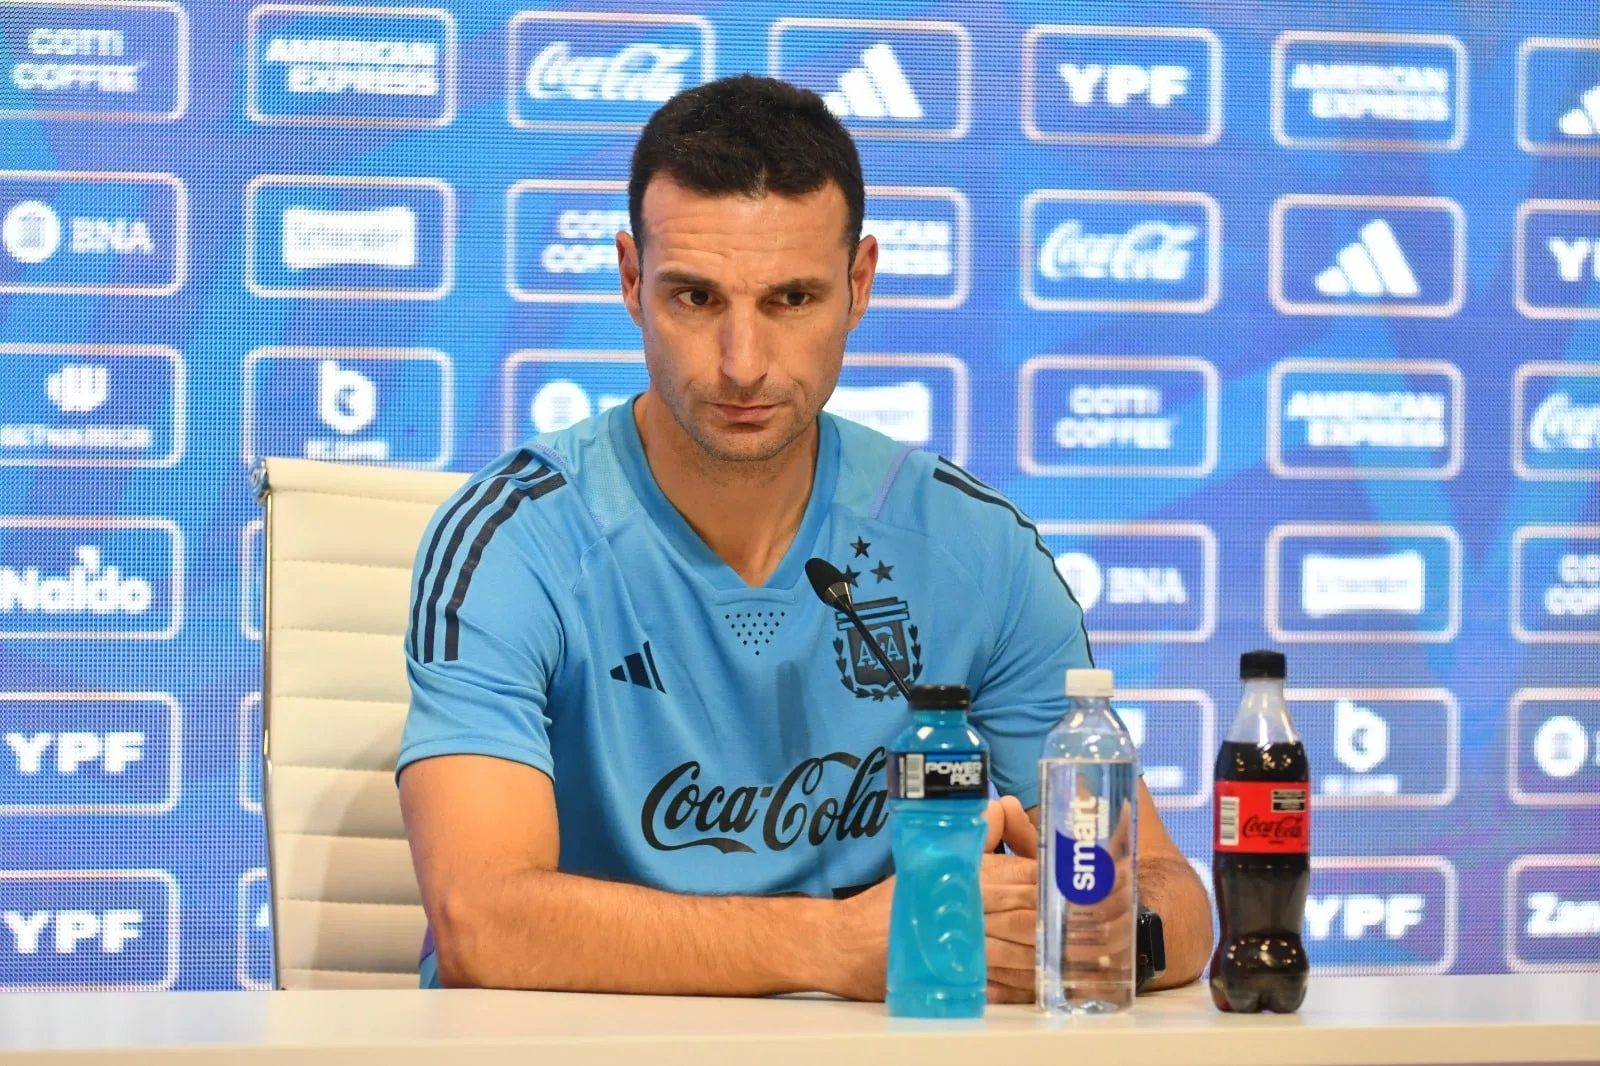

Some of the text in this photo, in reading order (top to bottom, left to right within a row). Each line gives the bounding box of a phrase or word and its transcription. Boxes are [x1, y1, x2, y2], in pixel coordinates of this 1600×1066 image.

[28, 27, 125, 56] COTTI
[265, 37, 438, 65] AMERICAN
[12, 62, 142, 93] COFFEE
[287, 66, 440, 96] EXPRESS
[1058, 63, 1191, 105] YPF
[1290, 63, 1449, 91] AMERICAN
[1311, 92, 1450, 121] EXPRESS
[69, 216, 155, 254] BNA
[541, 243, 620, 274] COFF
[1067, 386, 1163, 415] COTTI
[1287, 391, 1445, 420] AMERICAN
[1053, 417, 1175, 449] COFFEE
[1307, 420, 1446, 448] EXPRESS
[1106, 567, 1188, 604] BNA
[5, 732, 145, 774] YPF
[925, 761, 982, 776] POWER
[641, 745, 889, 855] Coca-Cola
[1069, 796, 1097, 891] smart
[3, 909, 144, 954] YPF
[1304, 893, 1426, 941] YPF
